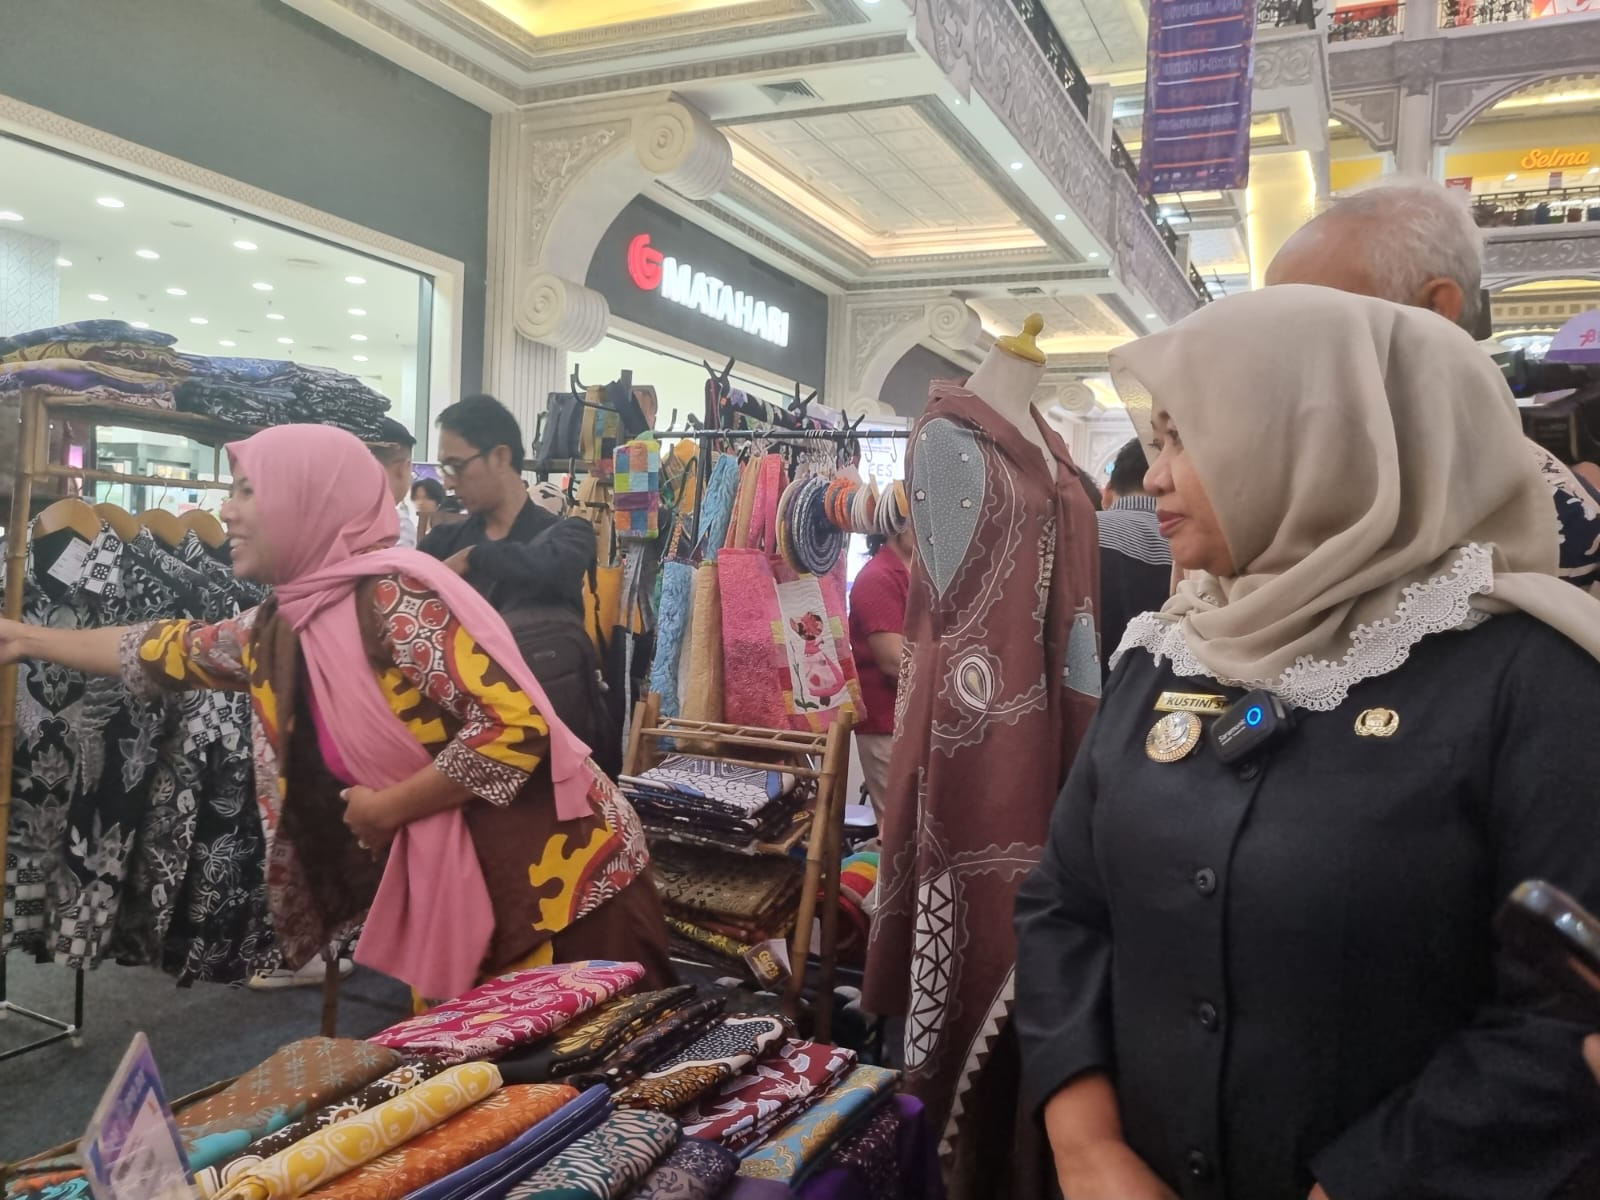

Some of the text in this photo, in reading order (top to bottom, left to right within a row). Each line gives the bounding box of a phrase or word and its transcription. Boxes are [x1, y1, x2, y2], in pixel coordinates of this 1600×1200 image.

[1521, 148, 1590, 170] Selma
[661, 256, 789, 348] MATAHARI
[1166, 696, 1213, 709] KUSTINI
